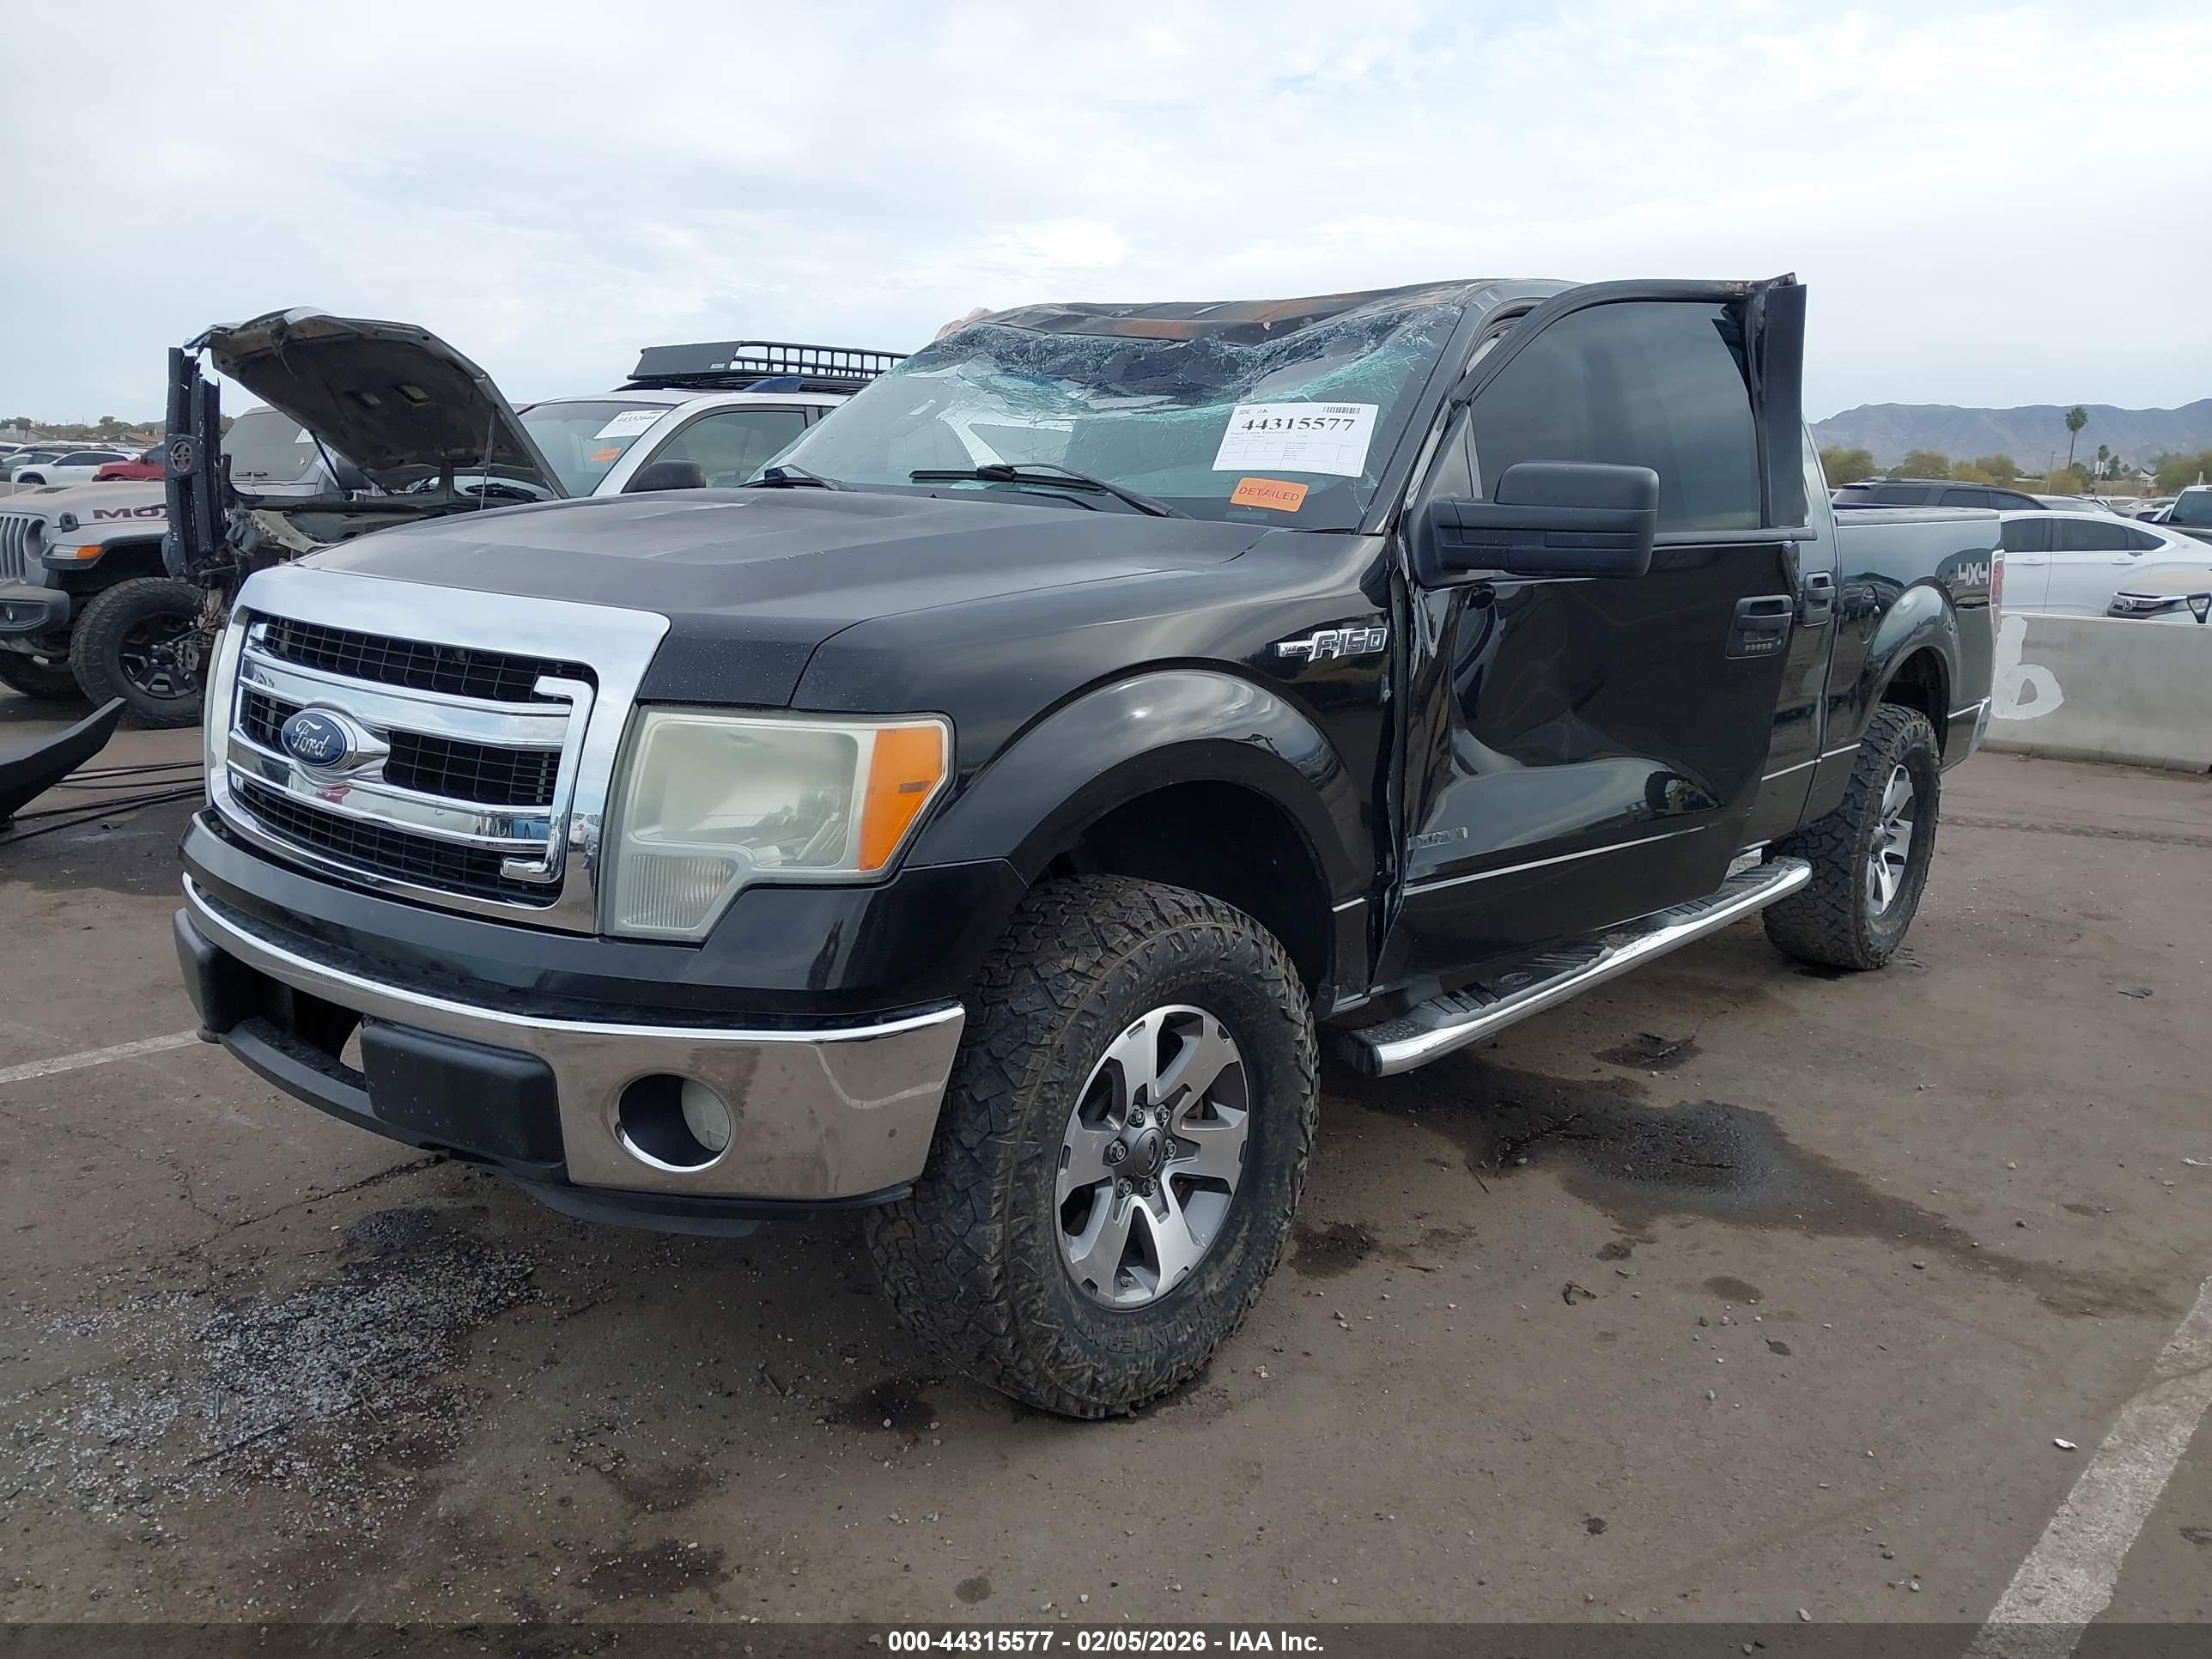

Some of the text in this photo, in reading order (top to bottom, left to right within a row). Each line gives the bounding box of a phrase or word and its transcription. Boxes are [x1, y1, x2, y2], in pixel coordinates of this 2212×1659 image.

[1242, 417, 1355, 431] 44315577
[1238, 487, 1300, 502] DETAILED
[92, 505, 168, 520] MO
[290, 719, 331, 757] Ford
